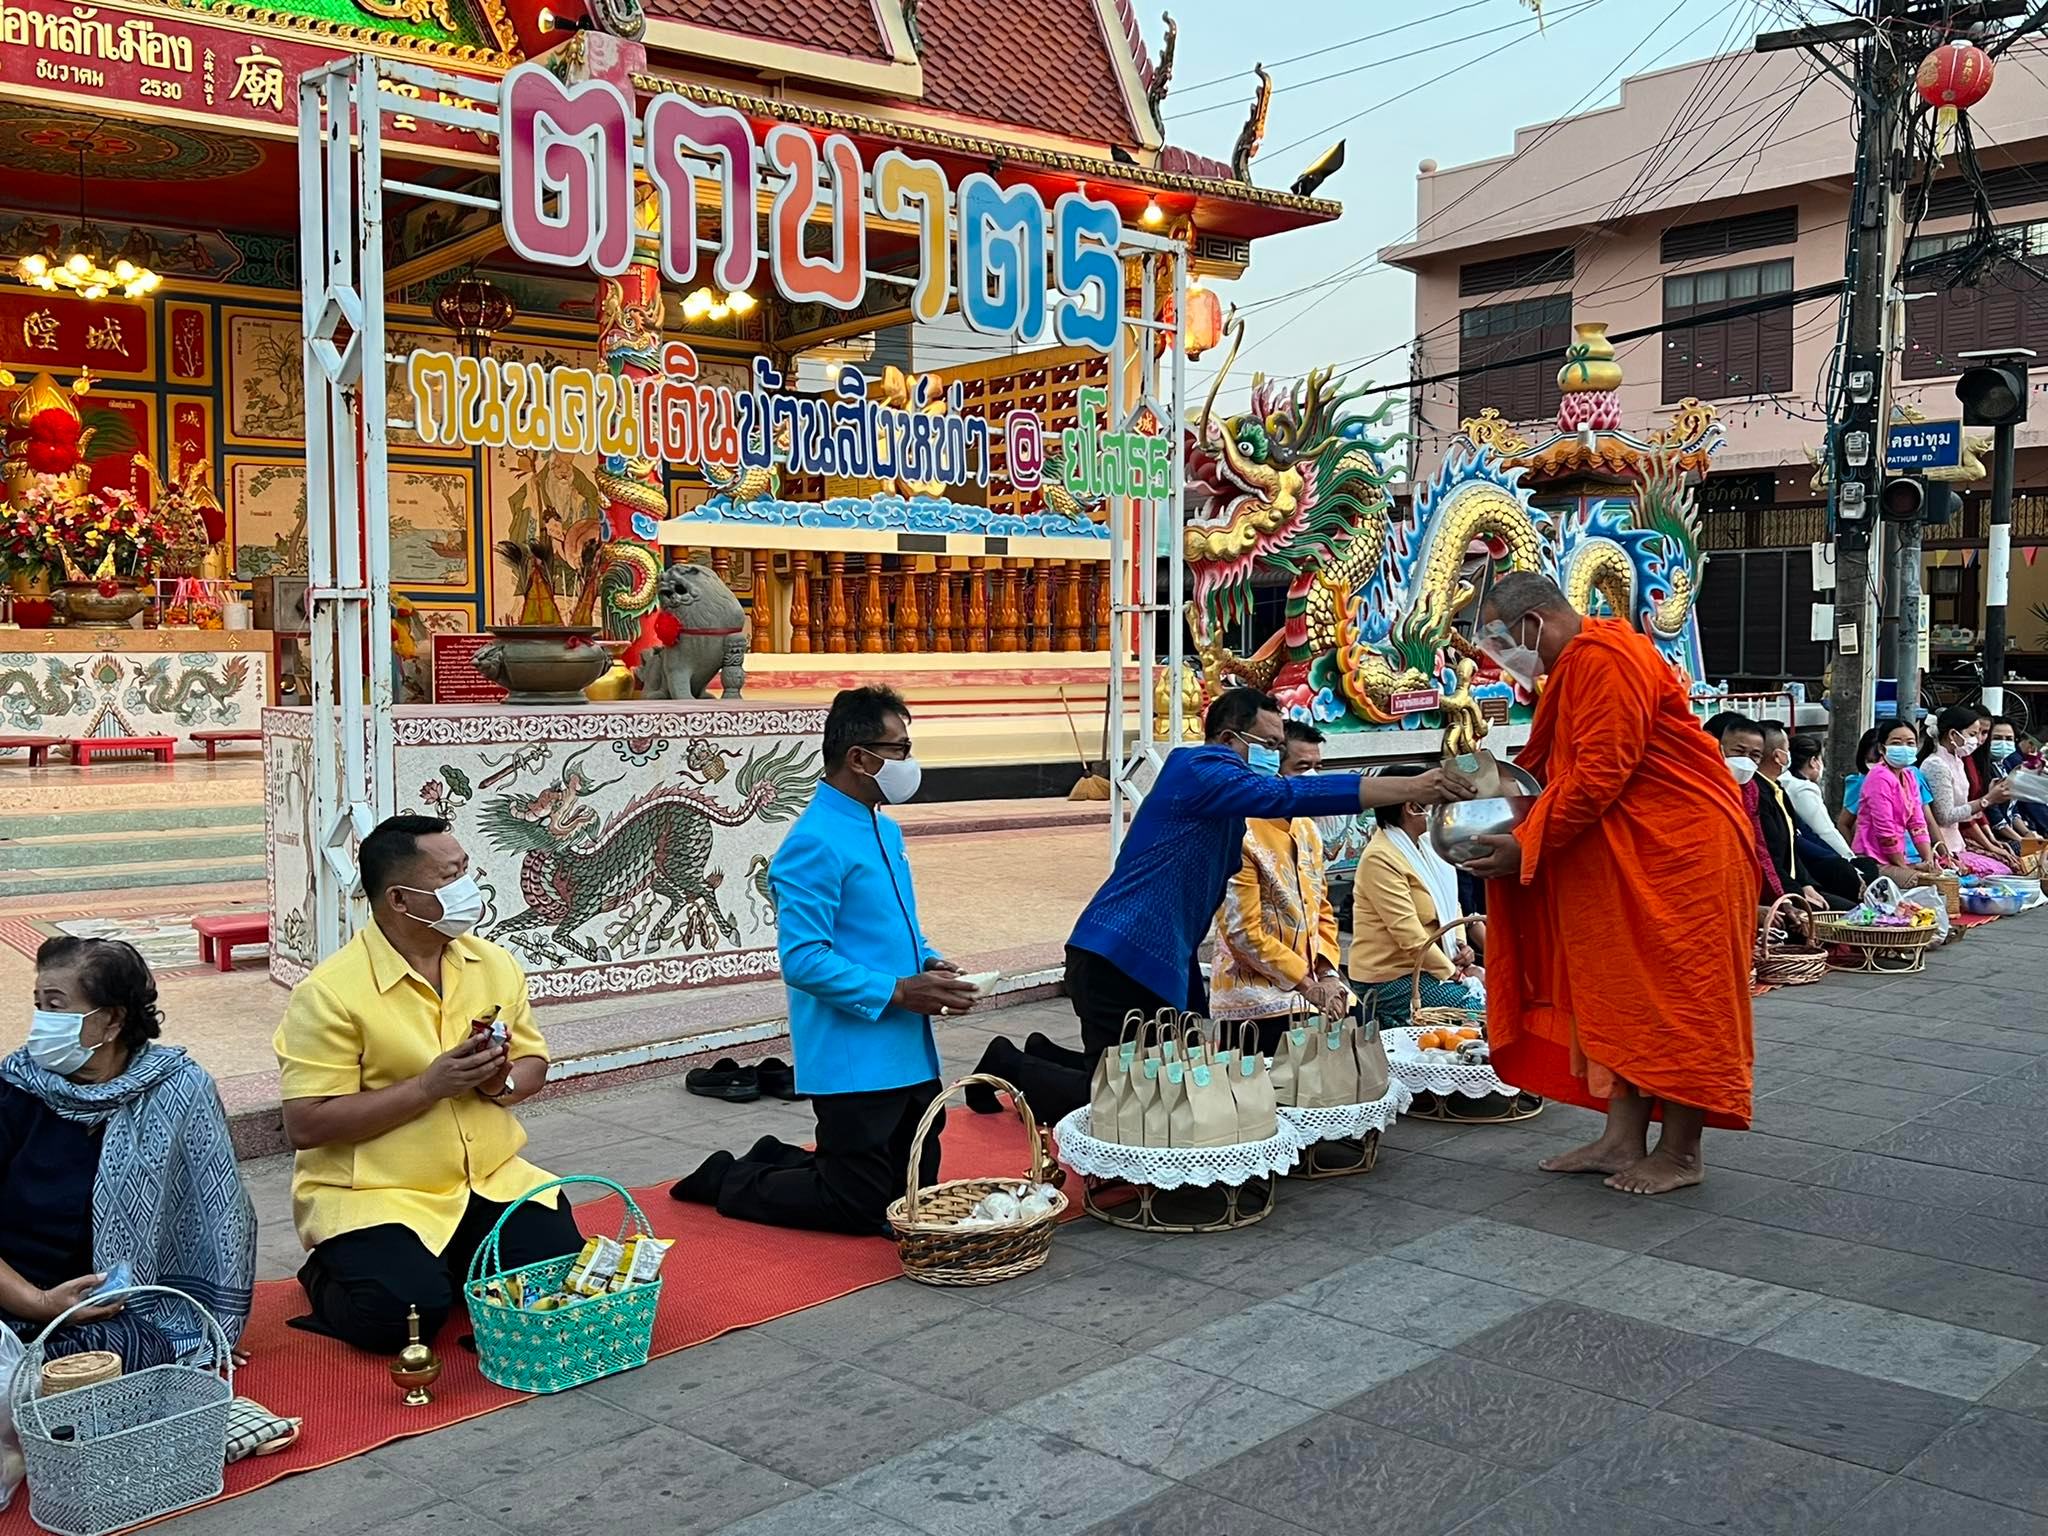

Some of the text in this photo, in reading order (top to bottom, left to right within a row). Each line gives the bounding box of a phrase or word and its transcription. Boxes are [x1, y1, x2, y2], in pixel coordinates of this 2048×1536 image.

[0, 0, 194, 73] อหลักเมือง
[139, 77, 182, 100] 2530
[1005, 408, 1045, 492] @
[1888, 432, 1951, 452] ครปทุม
[1887, 455, 1918, 464] PATHUM
